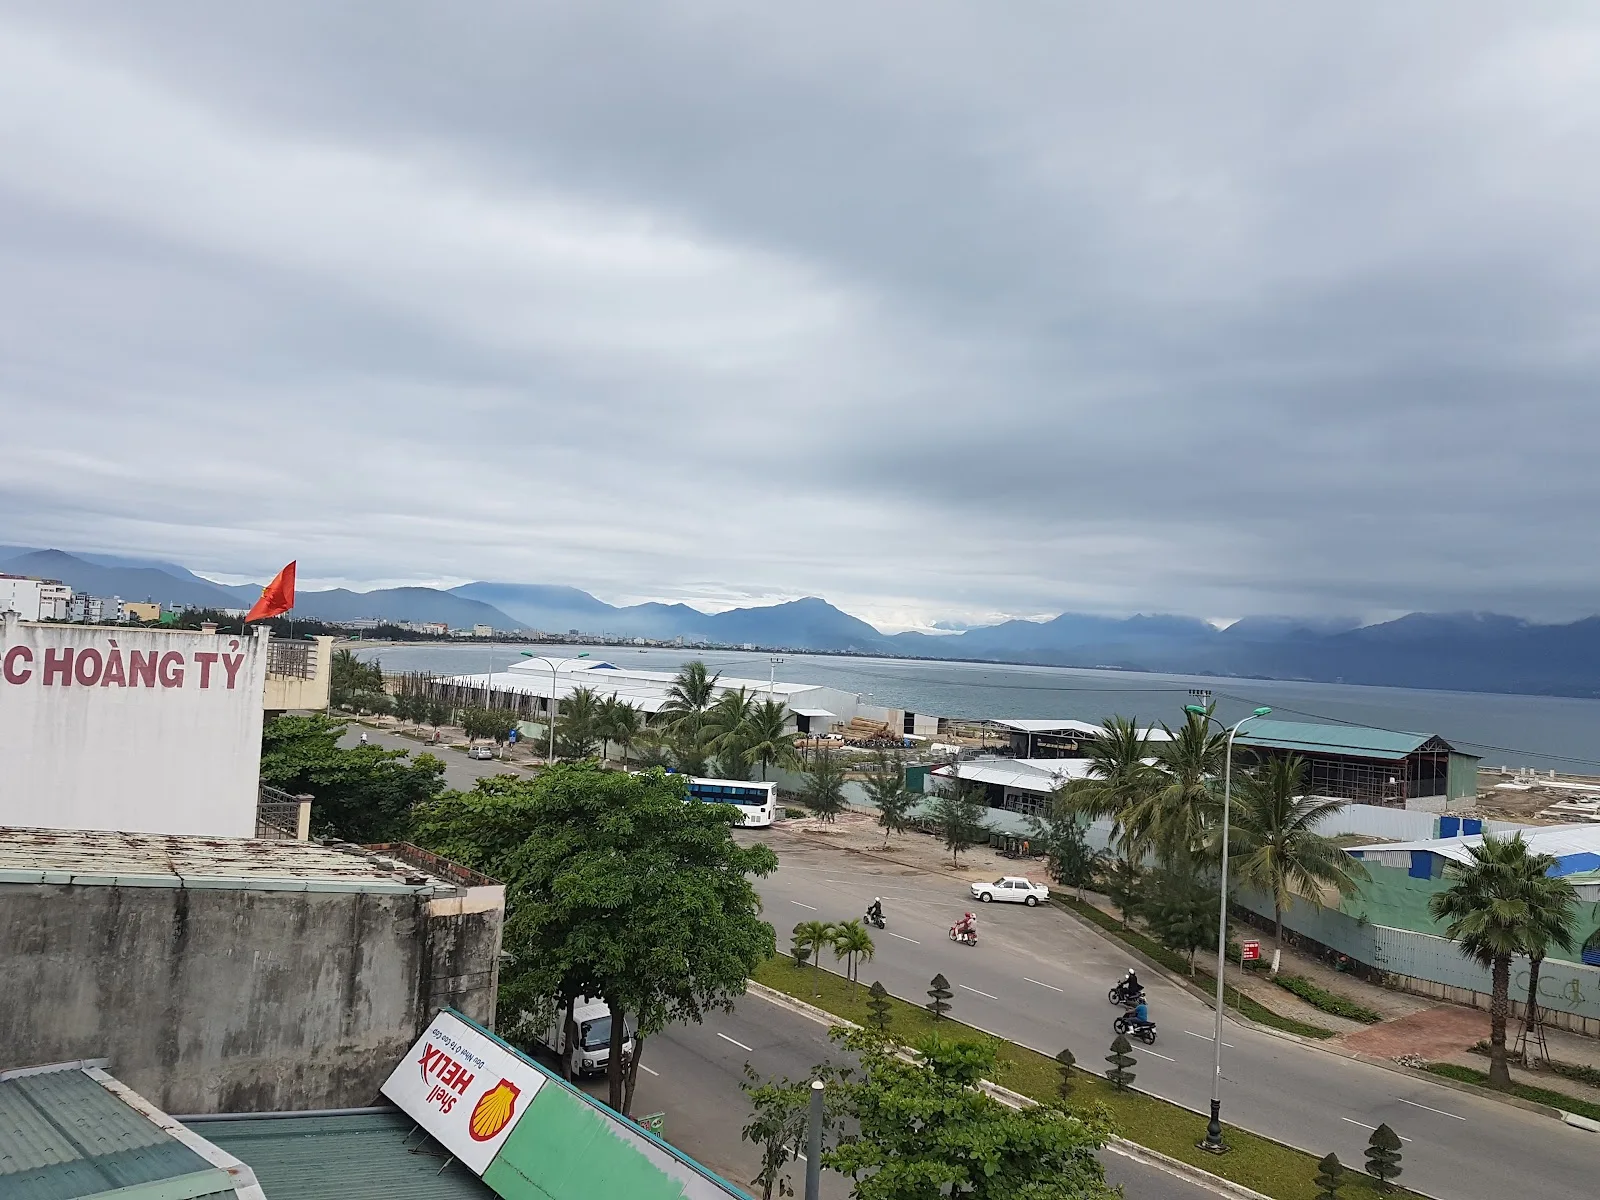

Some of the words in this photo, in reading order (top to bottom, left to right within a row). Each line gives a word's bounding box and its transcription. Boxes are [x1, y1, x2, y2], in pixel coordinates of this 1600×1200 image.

[42, 639, 185, 688] HOÀNG
[194, 640, 245, 689] TỶ
[417, 1042, 476, 1097] HELIX
[425, 1084, 458, 1114] Shell
